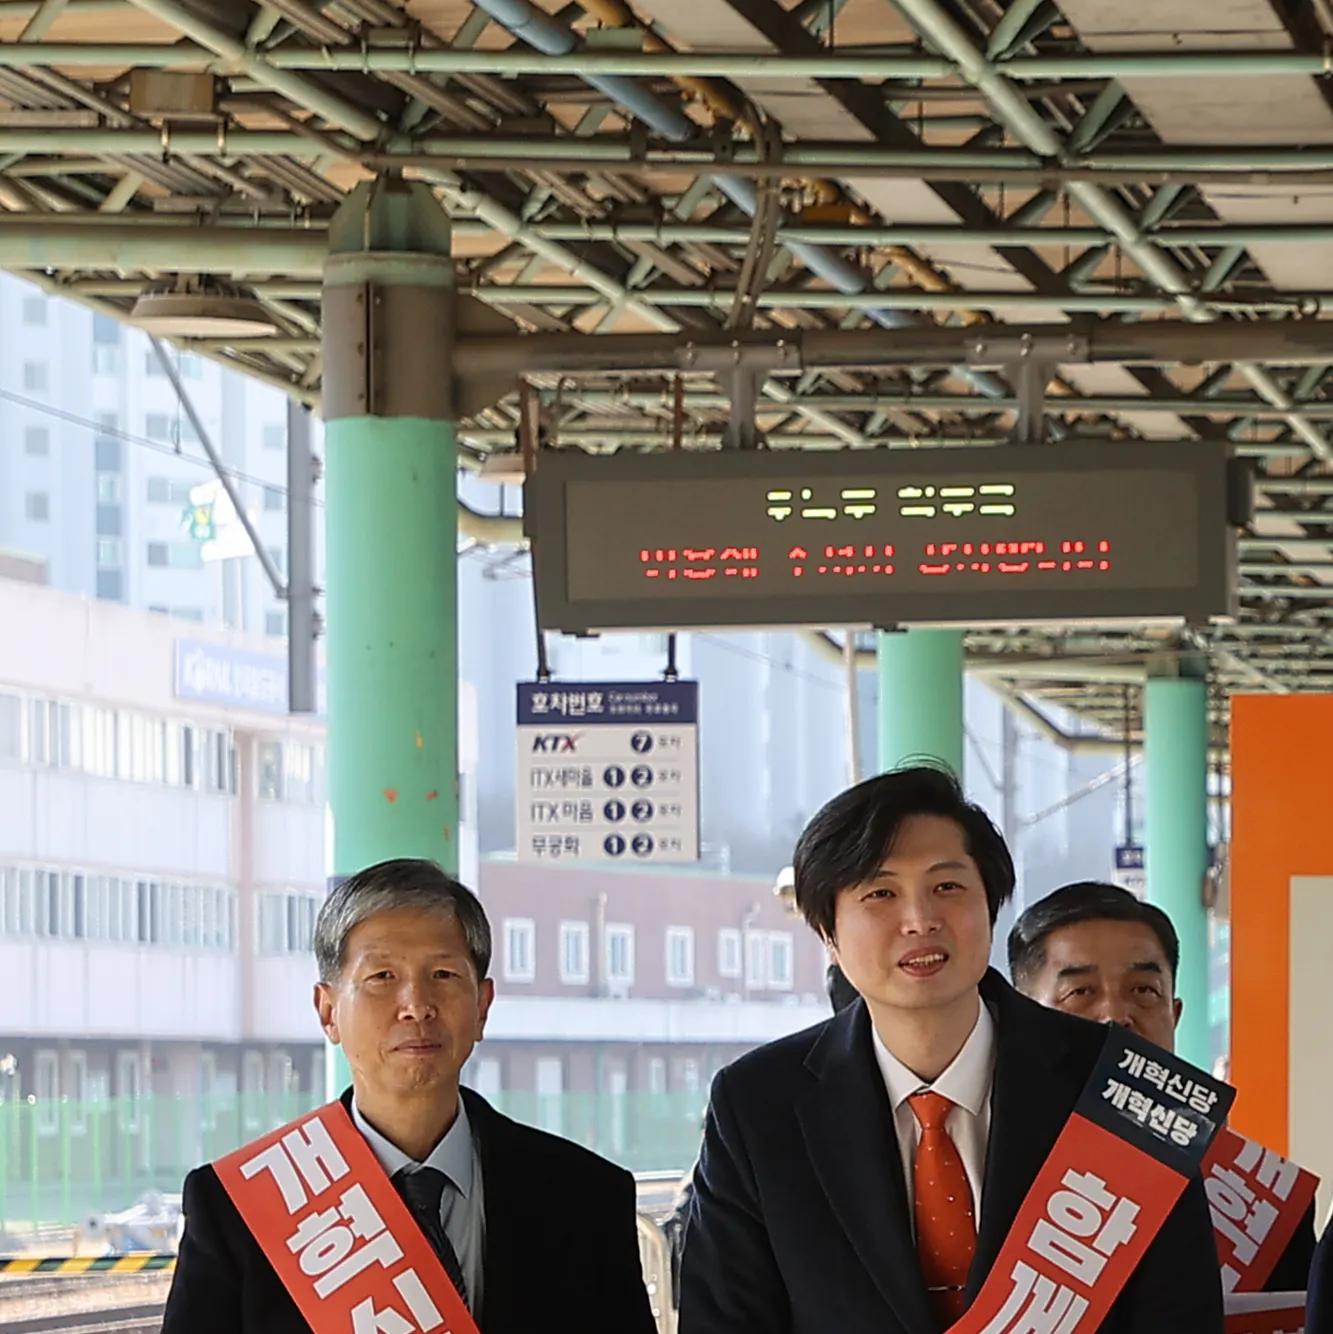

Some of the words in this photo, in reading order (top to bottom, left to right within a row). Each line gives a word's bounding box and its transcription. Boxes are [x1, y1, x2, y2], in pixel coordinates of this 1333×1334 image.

[532, 691, 603, 716] 호차번호
[532, 733, 579, 754] KTX
[1101, 1077, 1198, 1147] 개혁신당
[1118, 1048, 1219, 1115] 개혁신당
[1204, 1140, 1300, 1292] 개혁
